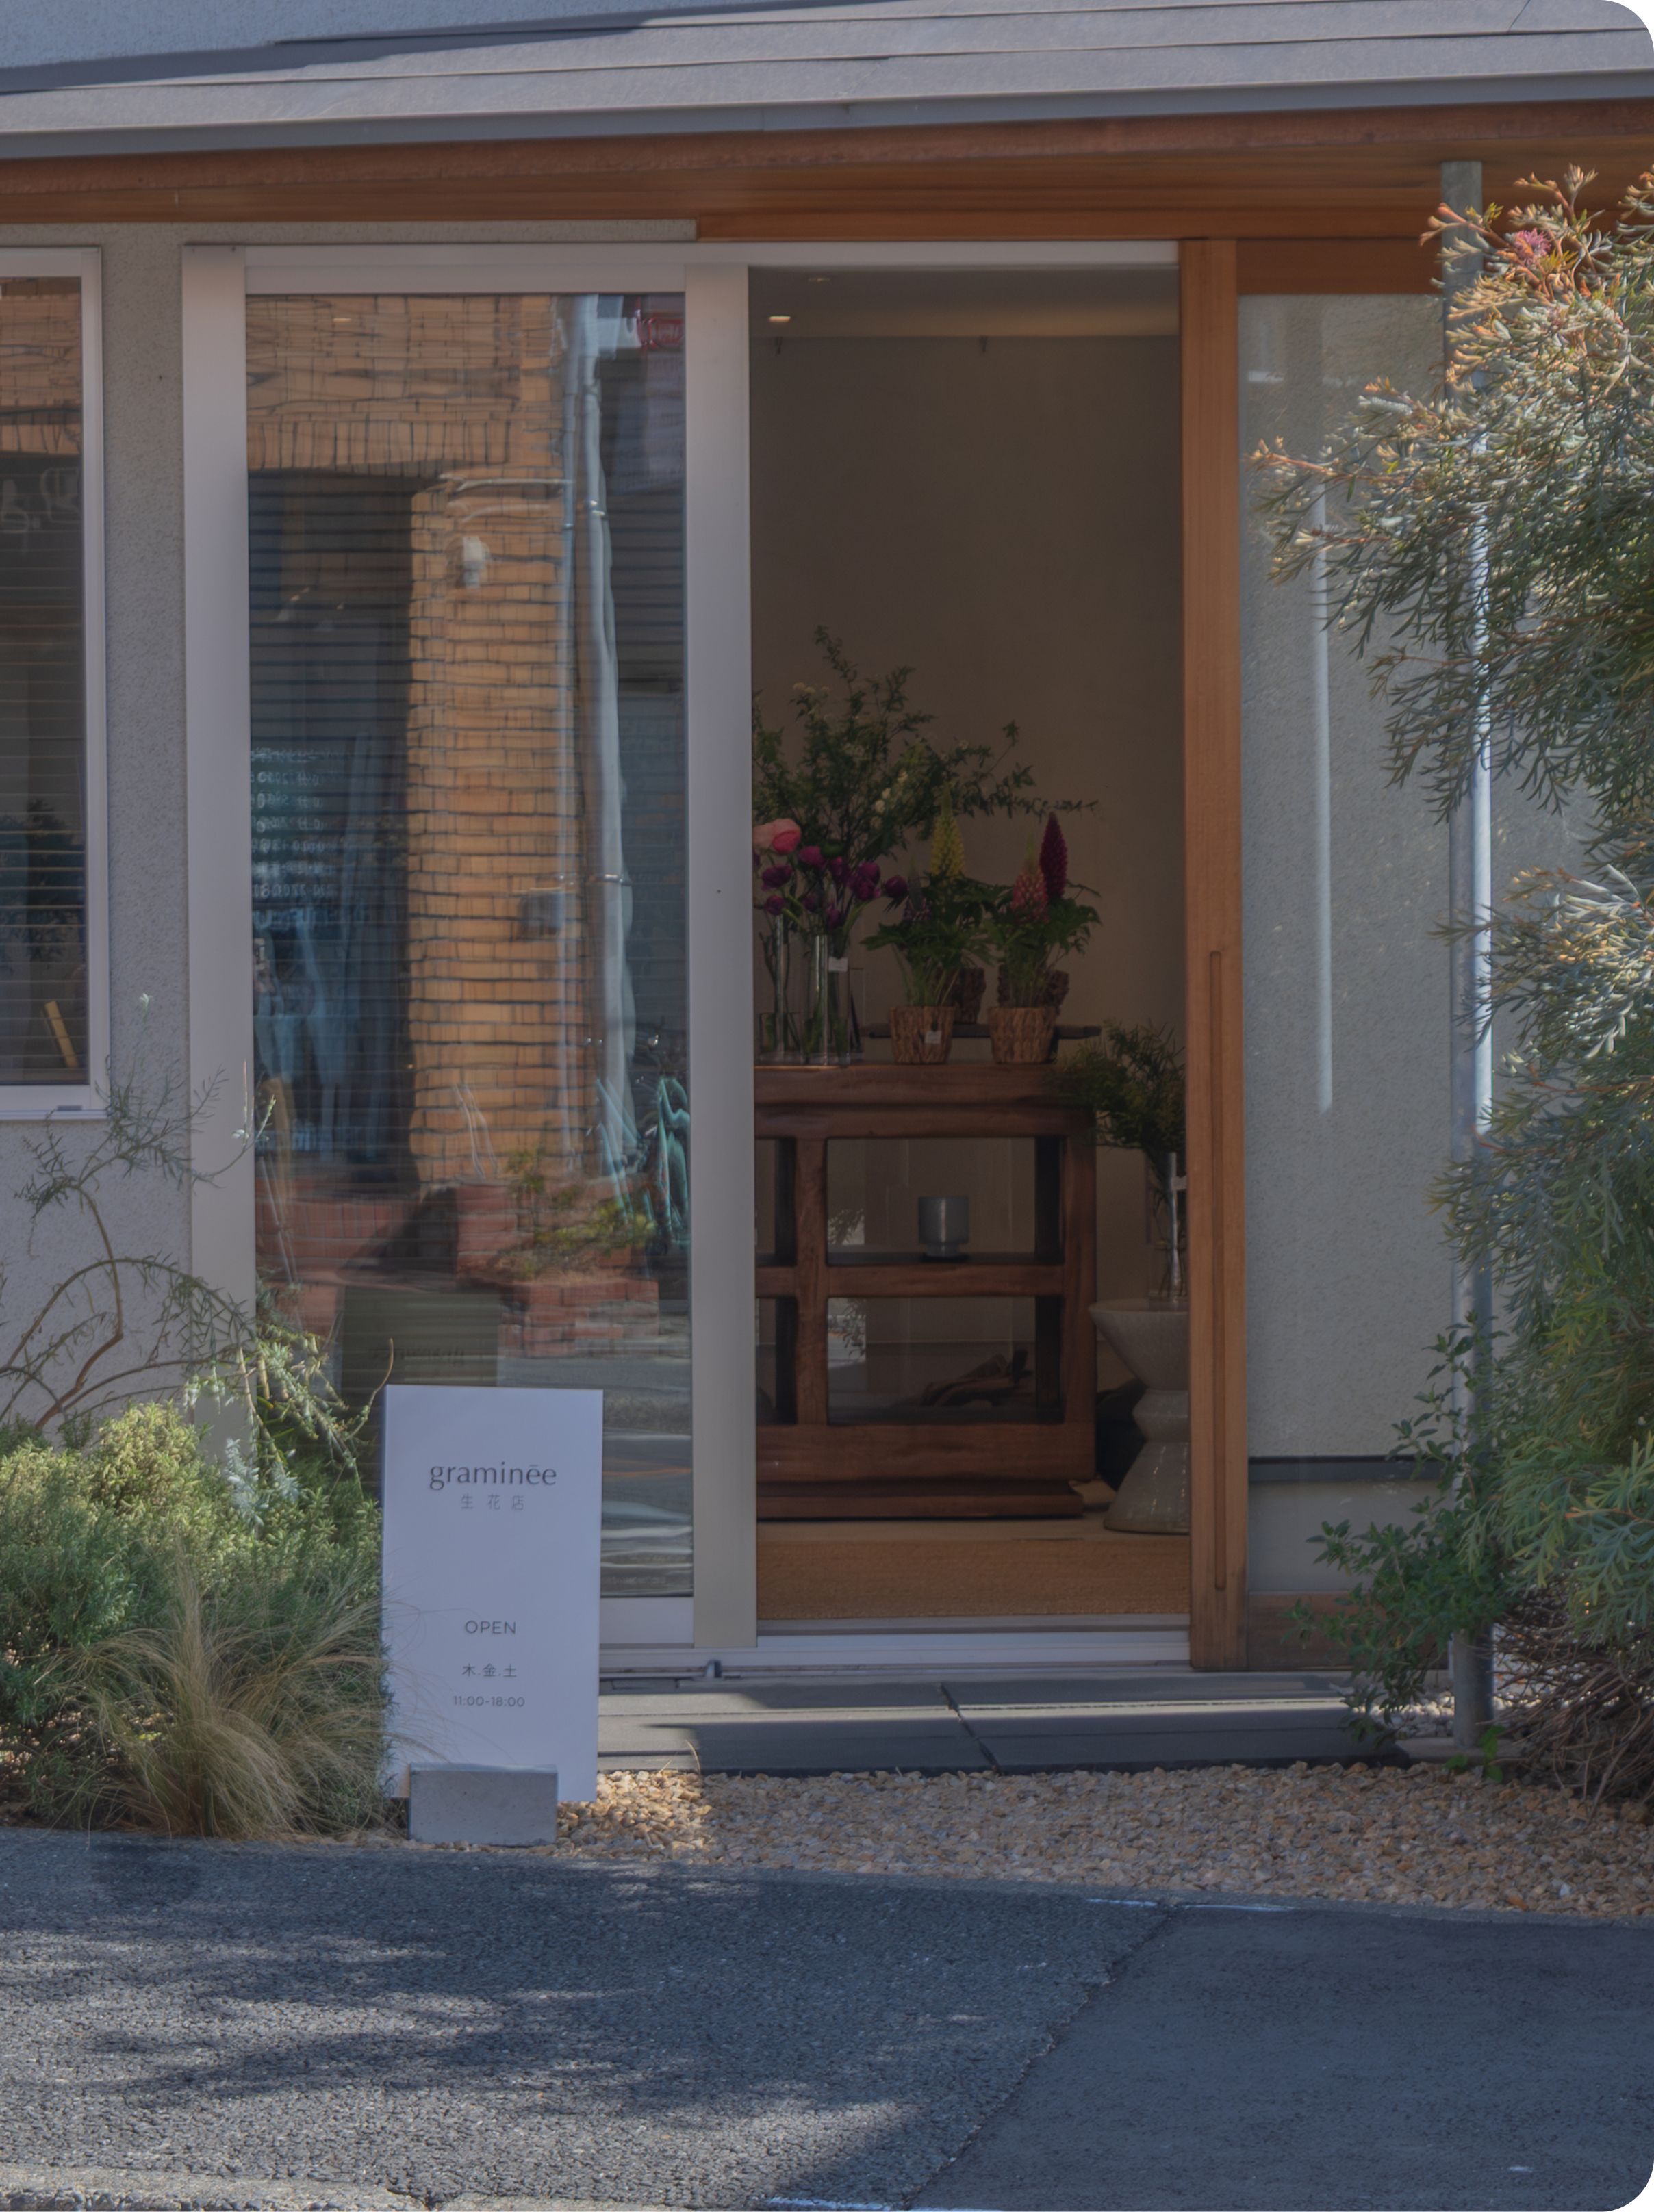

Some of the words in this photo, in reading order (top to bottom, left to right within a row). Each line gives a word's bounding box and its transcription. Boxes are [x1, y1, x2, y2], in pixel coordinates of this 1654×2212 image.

[461, 1493, 525, 1511] 生花店
[464, 1619, 516, 1635] OPEN
[453, 1695, 526, 1707] 11:00-18:00
